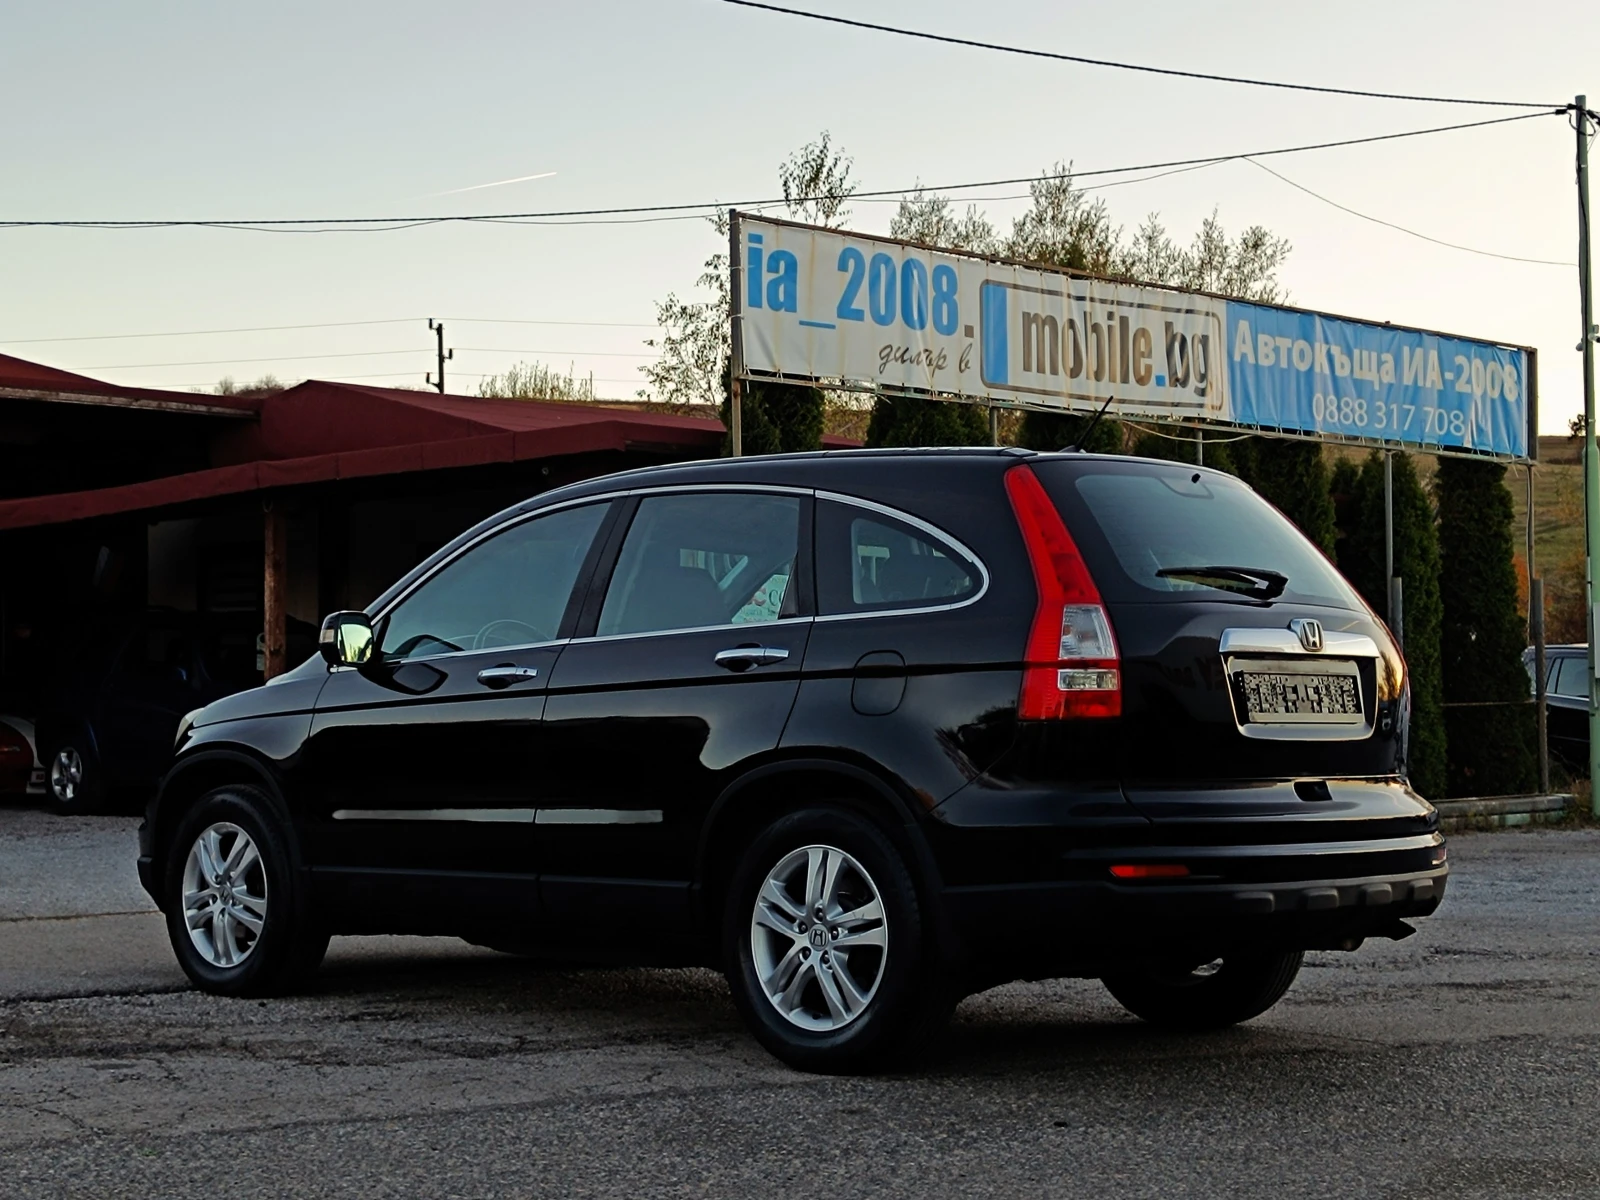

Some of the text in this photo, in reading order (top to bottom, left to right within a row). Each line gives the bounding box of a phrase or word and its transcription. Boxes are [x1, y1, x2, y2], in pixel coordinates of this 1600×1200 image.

[1022, 310, 1210, 396] mobile.bg
[1402, 345, 1518, 401] ИА-2008
[1312, 392, 1465, 436] 0888 317 708
